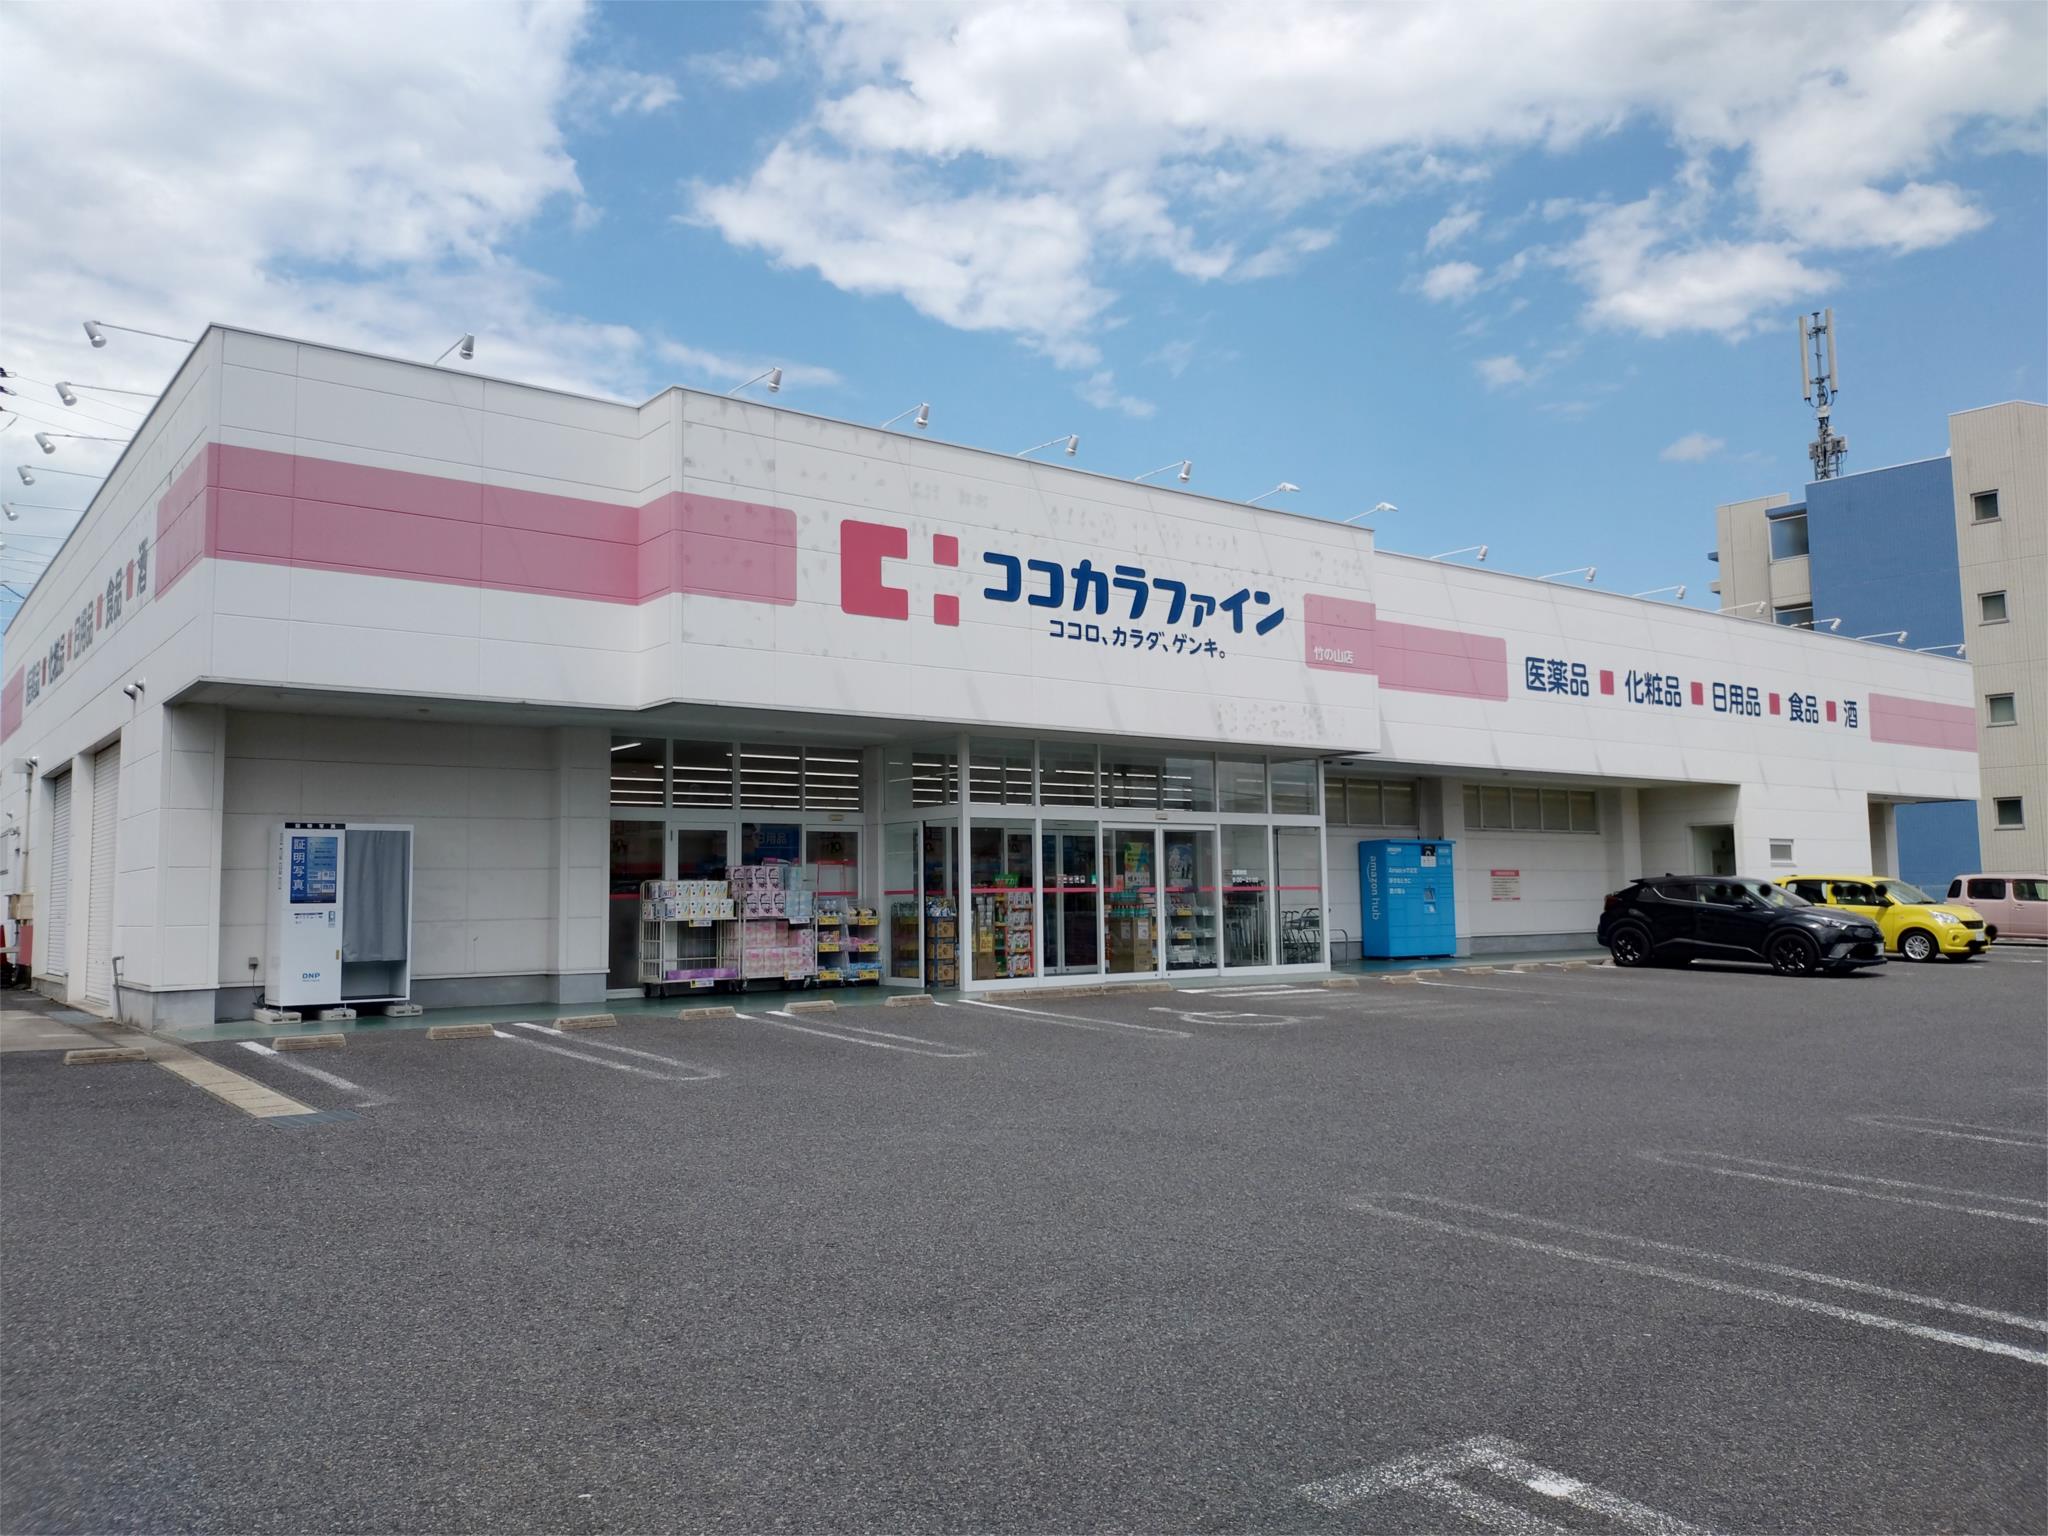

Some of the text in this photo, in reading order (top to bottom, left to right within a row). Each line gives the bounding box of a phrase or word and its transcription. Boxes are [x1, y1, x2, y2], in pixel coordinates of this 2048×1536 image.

[105, 567, 123, 630] 食品
[137, 536, 149, 597] 酒
[983, 551, 1285, 636] ココカラファイン
[1313, 645, 1354, 664] 竹の山店
[1525, 656, 1858, 729] 医薬品 化粧品 日用品 食品 酒
[292, 838, 306, 891] 証明写真
[1372, 898, 1381, 920] hub
[302, 972, 321, 980] DNP
